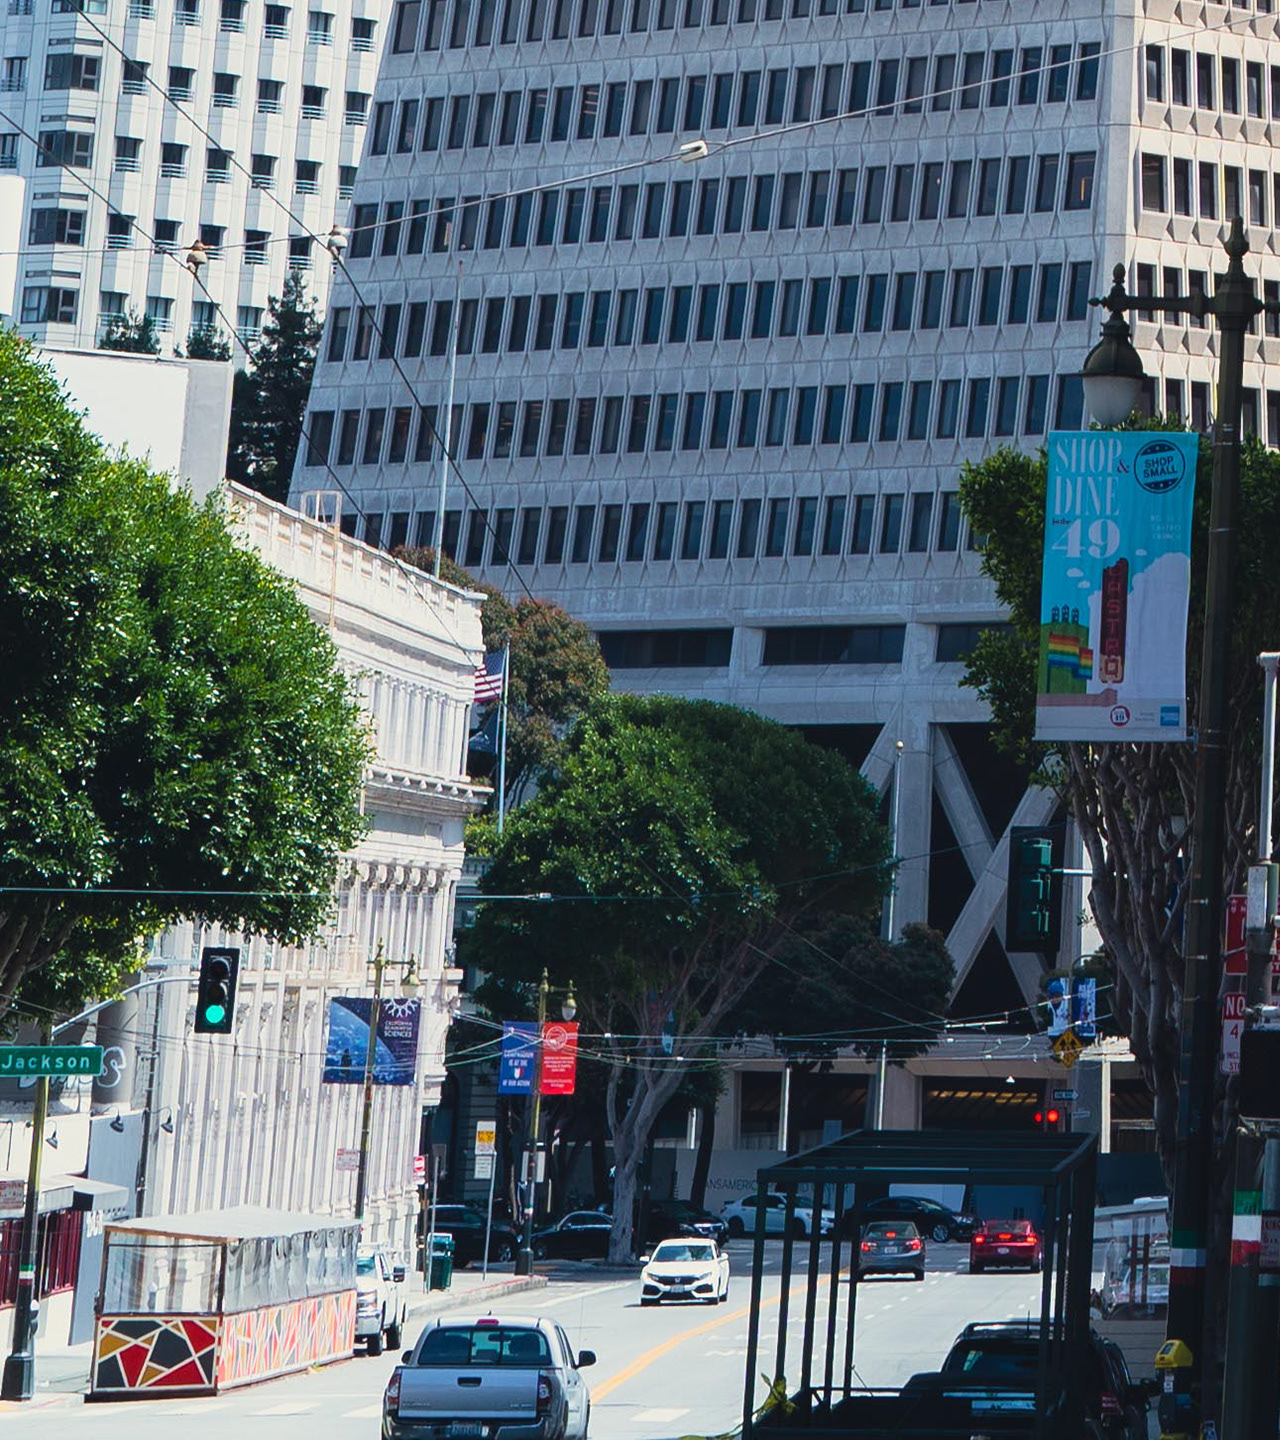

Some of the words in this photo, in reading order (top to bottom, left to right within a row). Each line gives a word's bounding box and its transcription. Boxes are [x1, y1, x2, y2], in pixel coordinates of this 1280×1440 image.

[1055, 438, 1122, 474] SHOP
[1116, 459, 1130, 474] &
[1144, 455, 1175, 469] SHOP
[1143, 465, 1179, 479] SMALL
[1054, 476, 1120, 516] DINE
[1051, 518, 1121, 559] 49
[384, 1030, 412, 1038] SCIENCES
[1, 1054, 90, 1070] Jackson
